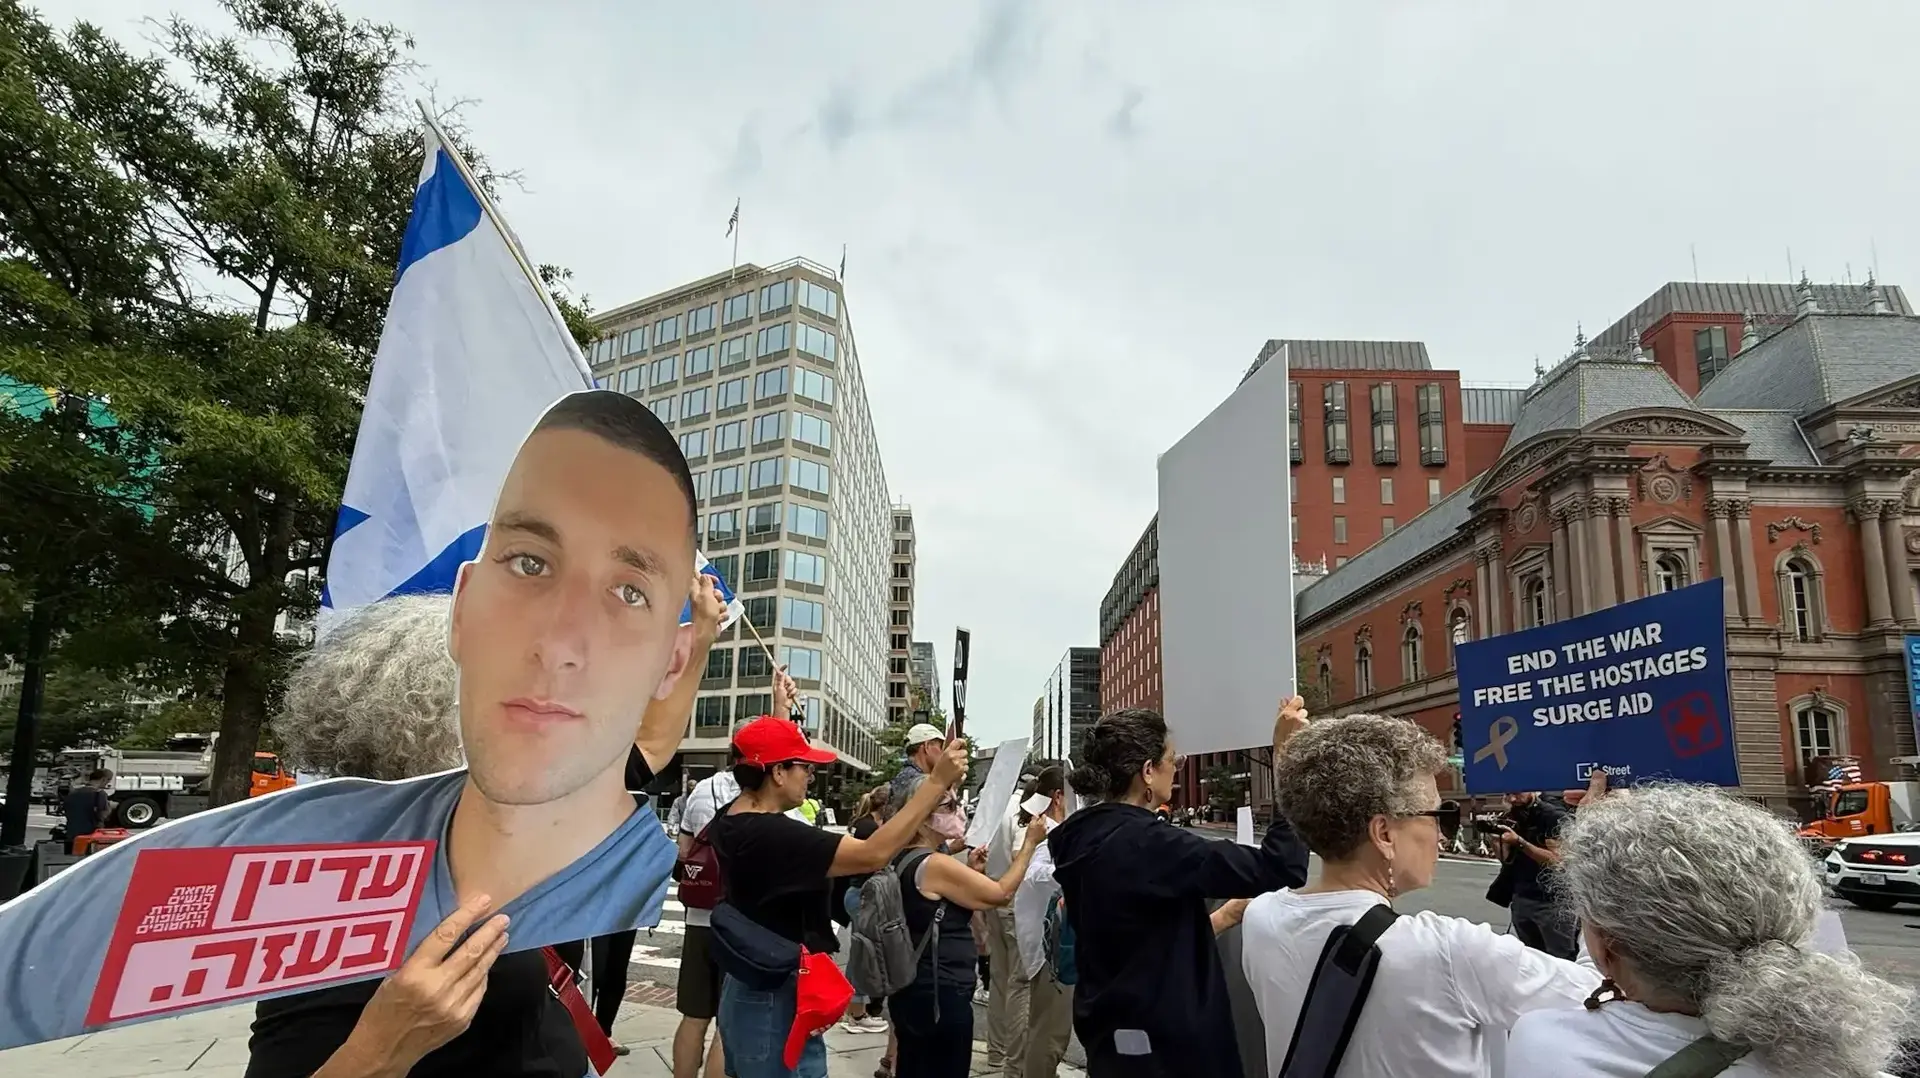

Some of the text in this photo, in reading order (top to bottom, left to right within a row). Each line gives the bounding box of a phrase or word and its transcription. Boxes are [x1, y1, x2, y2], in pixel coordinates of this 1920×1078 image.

[1507, 622, 1662, 675] END THE WAR
[1473, 647, 1708, 707] FREE THE HOSTAGES
[1533, 692, 1653, 727] SURGE AID
[1602, 764, 1631, 776] Street
[172, 885, 217, 896] מחאת
[230, 853, 416, 922] עדיין
[167, 894, 214, 905] הנשים
[149, 902, 212, 915] להחזרת
[142, 911, 209, 924] החטופות
[136, 919, 206, 934] והחטופים
[149, 920, 390, 1002] בעזה.
